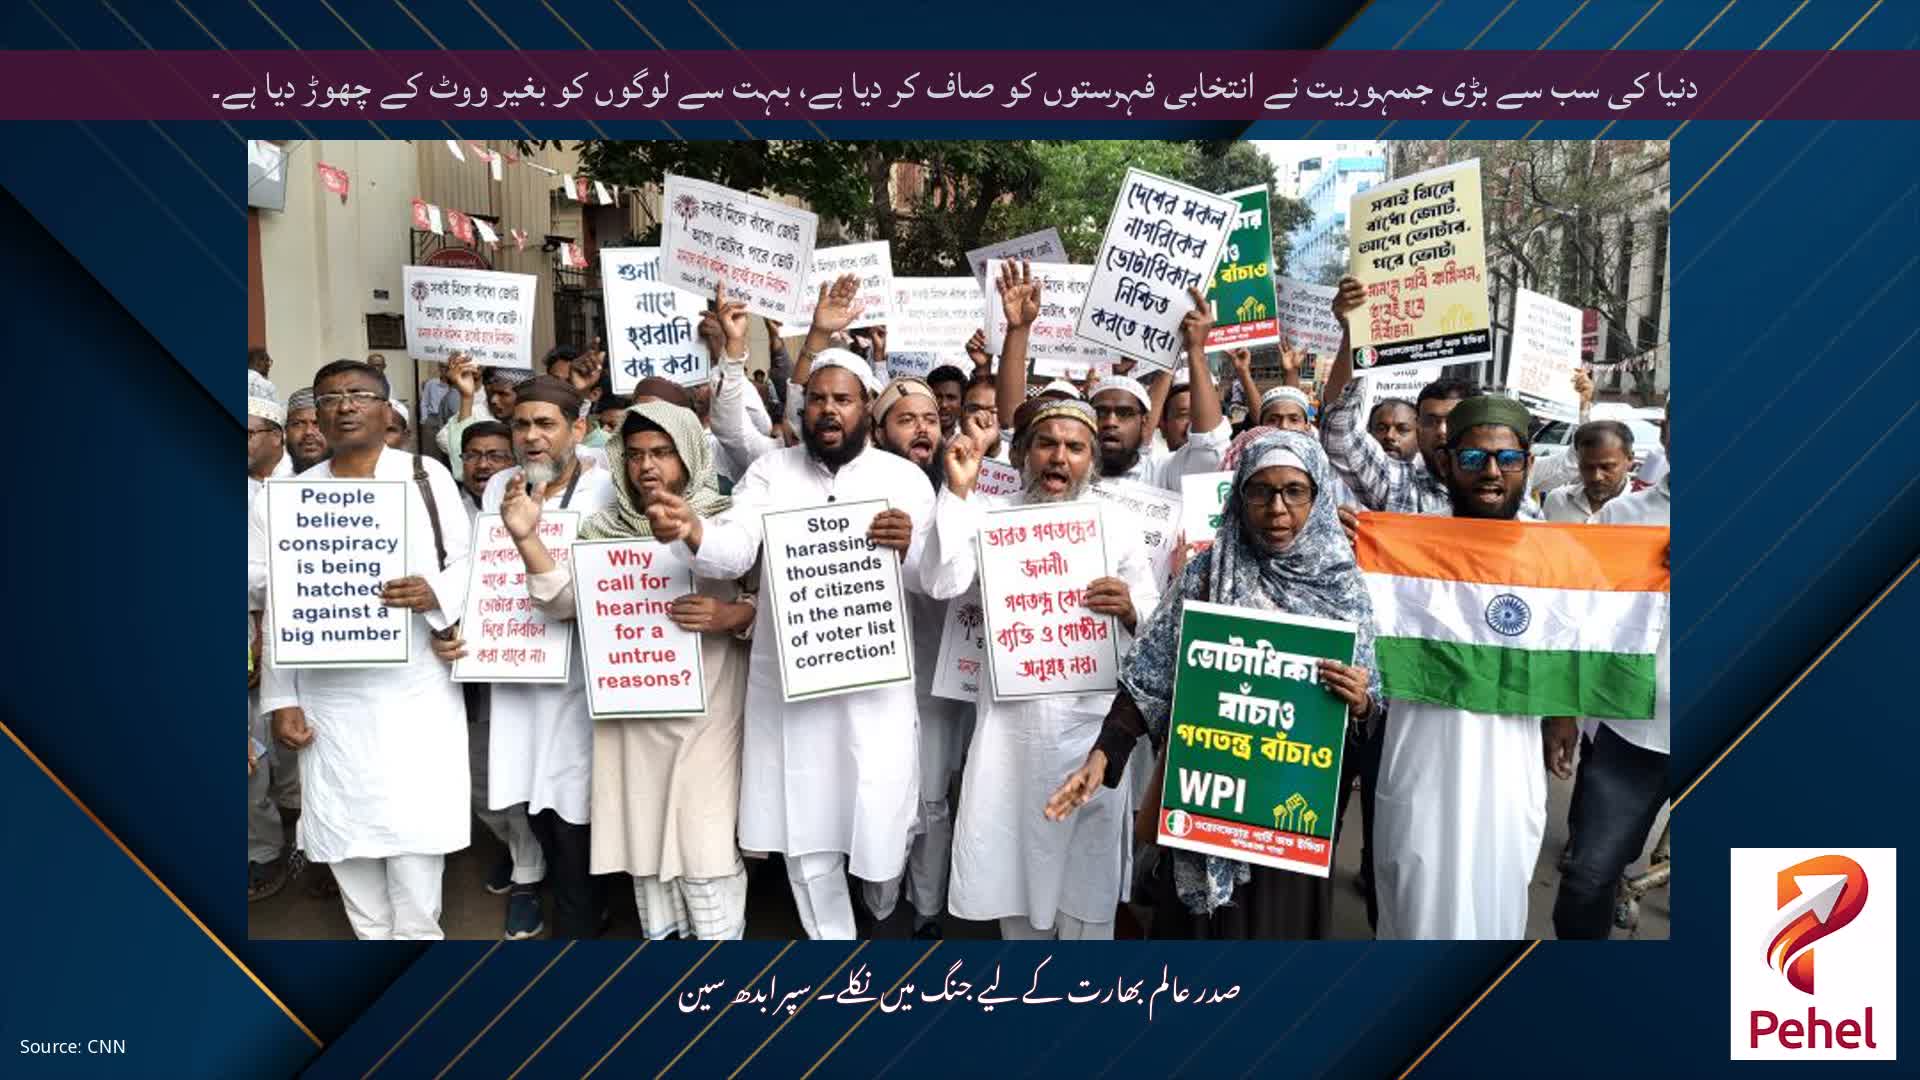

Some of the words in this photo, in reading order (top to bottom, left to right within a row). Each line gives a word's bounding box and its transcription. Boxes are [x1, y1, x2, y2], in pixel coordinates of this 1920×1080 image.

[1128, 182, 1179, 216] দেশের
[1182, 199, 1226, 231] সকল
[1371, 188, 1409, 213] সবাই
[1413, 179, 1455, 202] মিলে
[1124, 216, 1208, 260] নাগরিকের
[1358, 232, 1401, 254] আগে
[1221, 262, 1267, 283] বাঁচাও
[1373, 251, 1404, 272] পরে
[635, 291, 676, 317] নামে
[1114, 276, 1171, 315] নিশ্চিত
[625, 316, 692, 350] হয়রানি
[1091, 308, 1138, 341] করতে
[991, 471, 1015, 484] are
[301, 488, 375, 507] People
[297, 512, 380, 529] believe,
[807, 516, 850, 533] Stop
[279, 536, 398, 554] conspiracy
[984, 526, 1027, 547] ভারত
[1032, 519, 1097, 544] গণতন্ত্রের
[608, 549, 653, 570] Why
[785, 536, 878, 559] harassing
[297, 560, 315, 575] is
[322, 559, 382, 577] being
[786, 556, 882, 582] thousands
[297, 581, 384, 598] hatched
[597, 573, 634, 591] call
[640, 572, 671, 589] for
[789, 587, 807, 603] of
[815, 578, 885, 599] citizens
[292, 603, 371, 623] against
[377, 606, 389, 618] a
[787, 610, 804, 626] in
[809, 607, 839, 622] the
[844, 599, 893, 617] name
[1004, 592, 1054, 615] গণতন্ত্র
[281, 628, 315, 646] big
[321, 627, 401, 642] number
[616, 623, 645, 640] for
[651, 625, 664, 639] a
[791, 630, 809, 648] of
[816, 625, 863, 644] voter
[867, 618, 896, 636] list
[996, 623, 1035, 652] ব্যক্তি
[1041, 626, 1054, 642] ও
[1058, 616, 1108, 647] গোষ্ঠীর
[608, 648, 676, 665] untrue
[795, 641, 897, 669] correction!
[1187, 634, 1341, 690] ভোটাধিকা
[597, 670, 692, 689] reasons?
[1016, 656, 1067, 682] অনুগ্রহ
[1217, 681, 1296, 731] বাঁচাও
[1177, 723, 1252, 760] গণতন্ত্র
[1260, 732, 1333, 769] বাঁচাও
[1178, 767, 1247, 814] WPI
